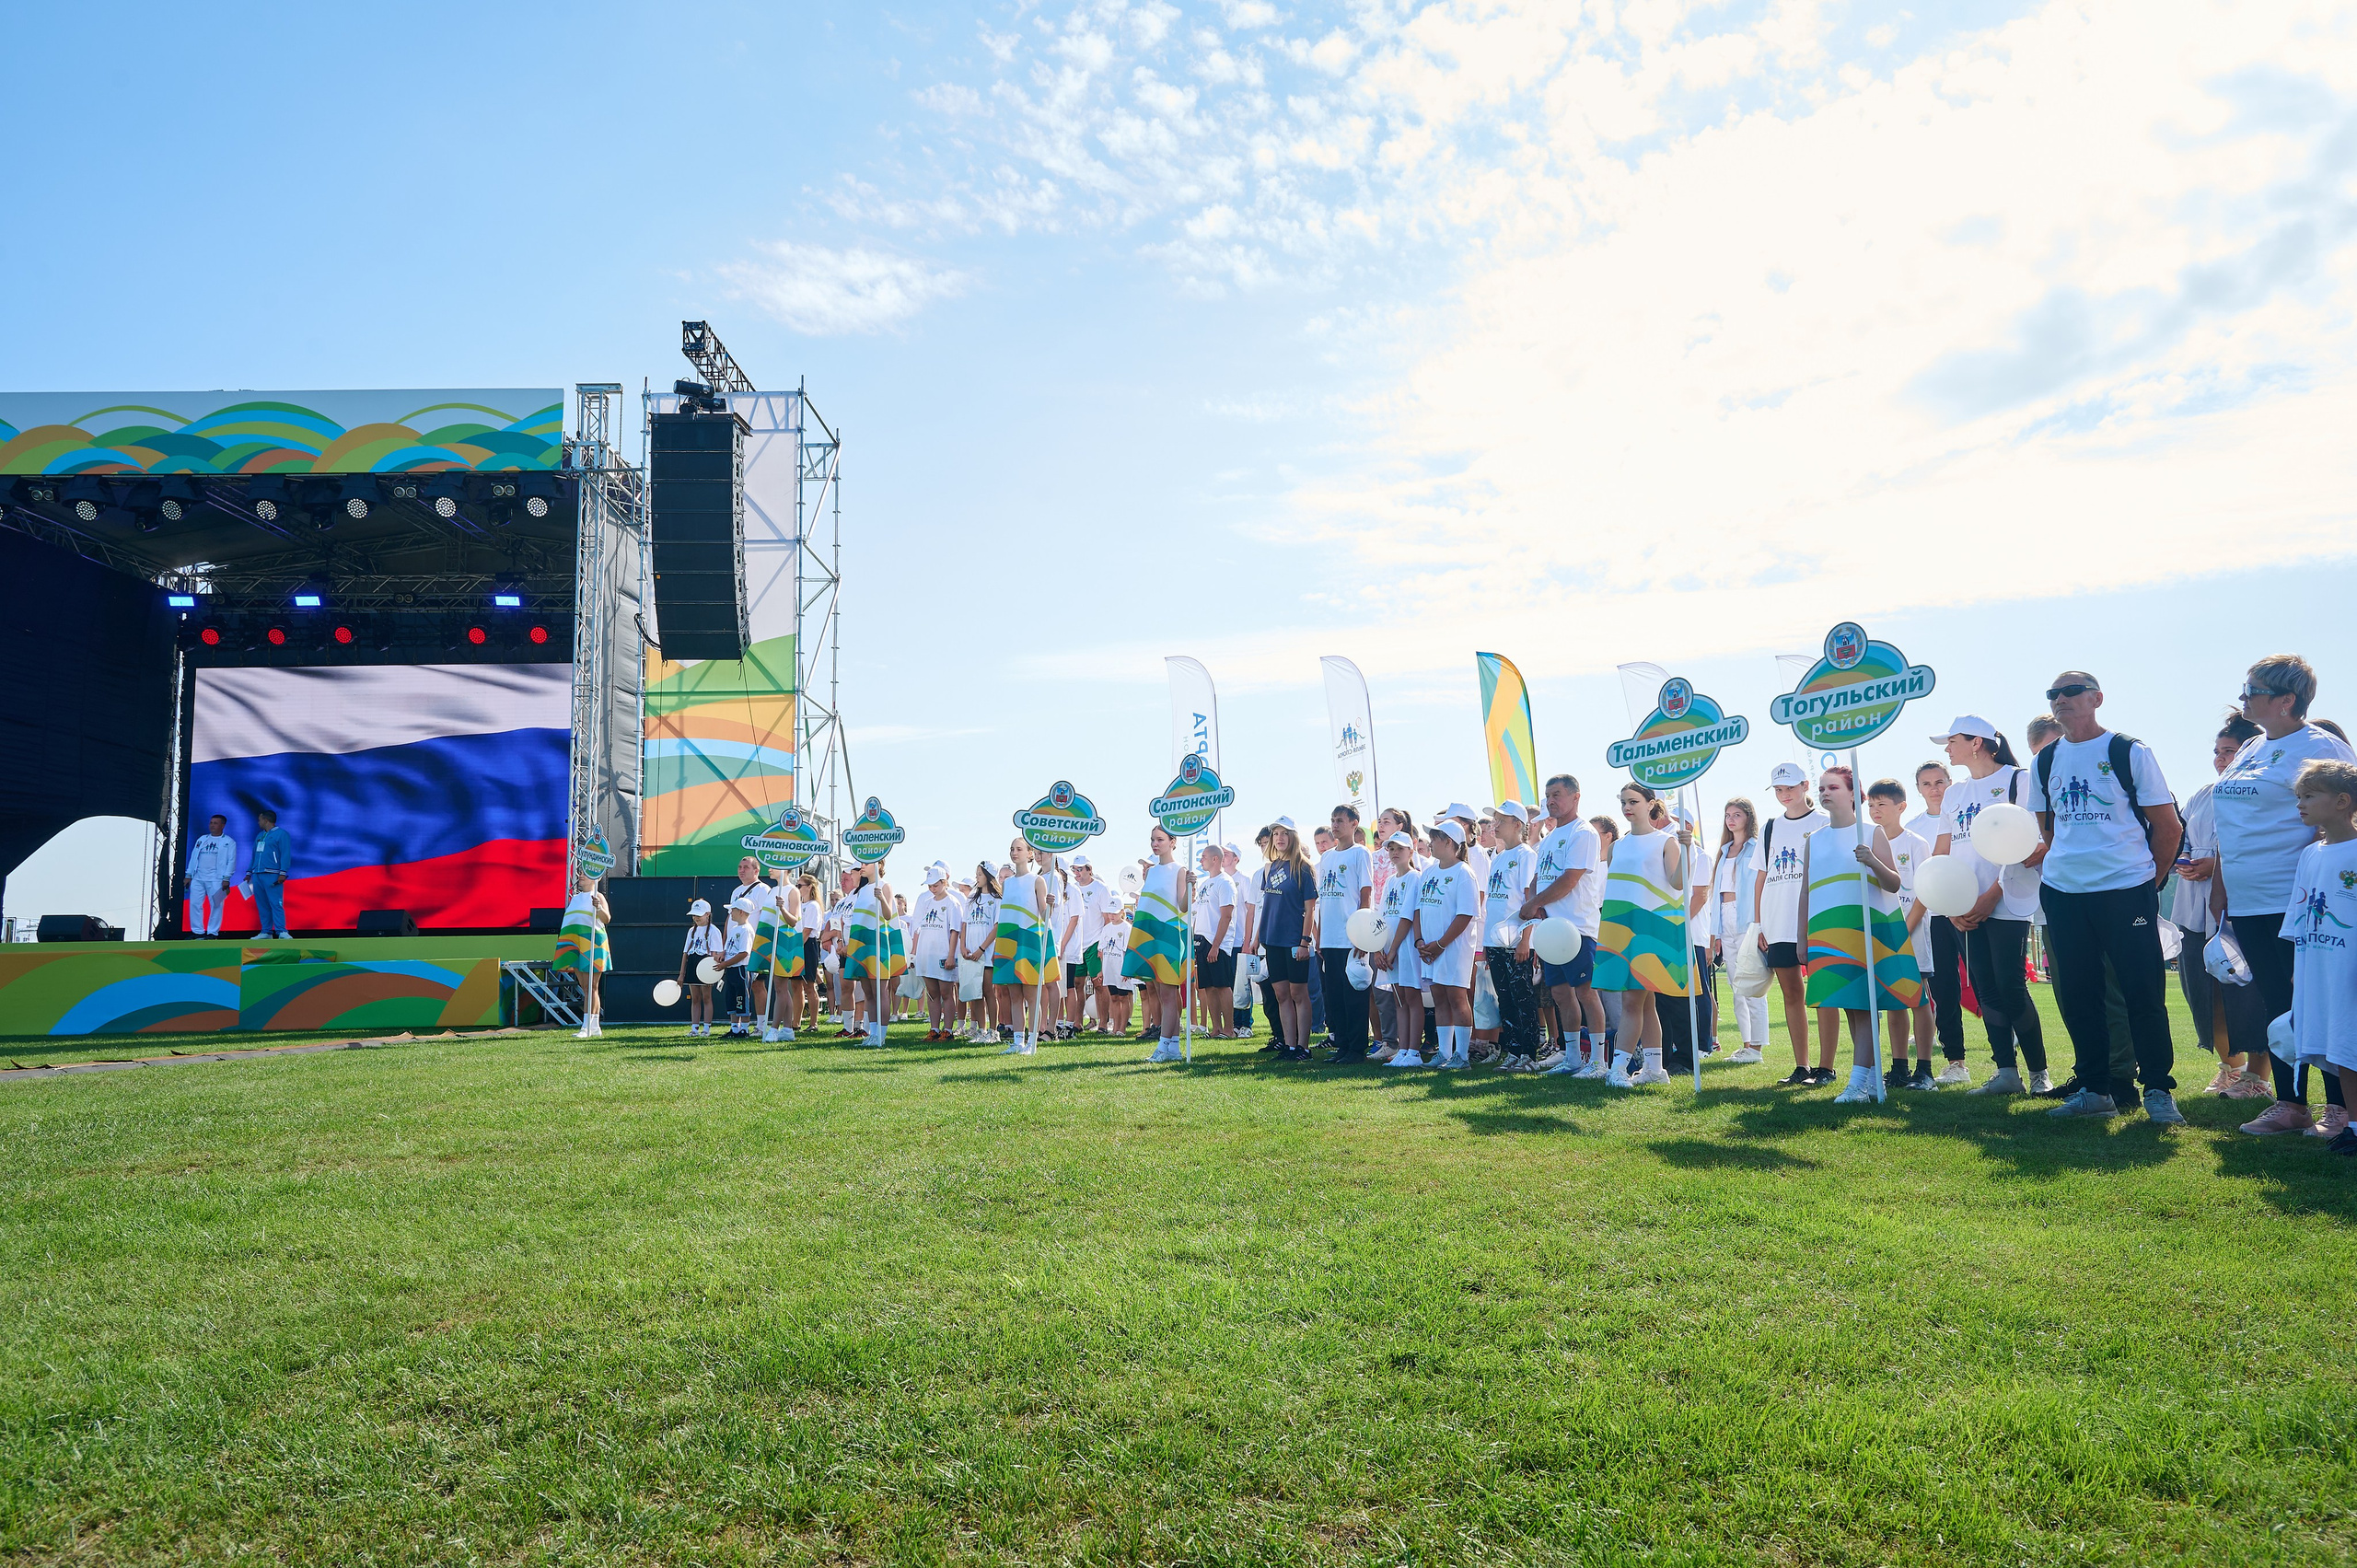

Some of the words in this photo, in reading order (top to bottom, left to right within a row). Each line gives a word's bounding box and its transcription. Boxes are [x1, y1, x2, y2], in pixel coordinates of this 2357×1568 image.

[1781, 669, 1924, 718] Тогульский
[1811, 712, 1881, 741] район
[1613, 719, 1742, 763] Тальменский
[1644, 757, 1701, 782] район
[2224, 786, 2258, 796] СПОРТА
[1153, 789, 1231, 815] Солтонский
[1020, 812, 1099, 832] Советский
[1169, 813, 1207, 830] район
[2074, 812, 2111, 821] СПОРТА
[744, 836, 829, 853] Кытмановский
[845, 830, 901, 842] Смоленский
[1032, 831, 1075, 844] район
[577, 846, 614, 865] Кулундинский
[764, 853, 802, 864] район
[856, 845, 885, 857] район
[585, 864, 601, 874] район
[1265, 887, 1283, 895] Columbia
